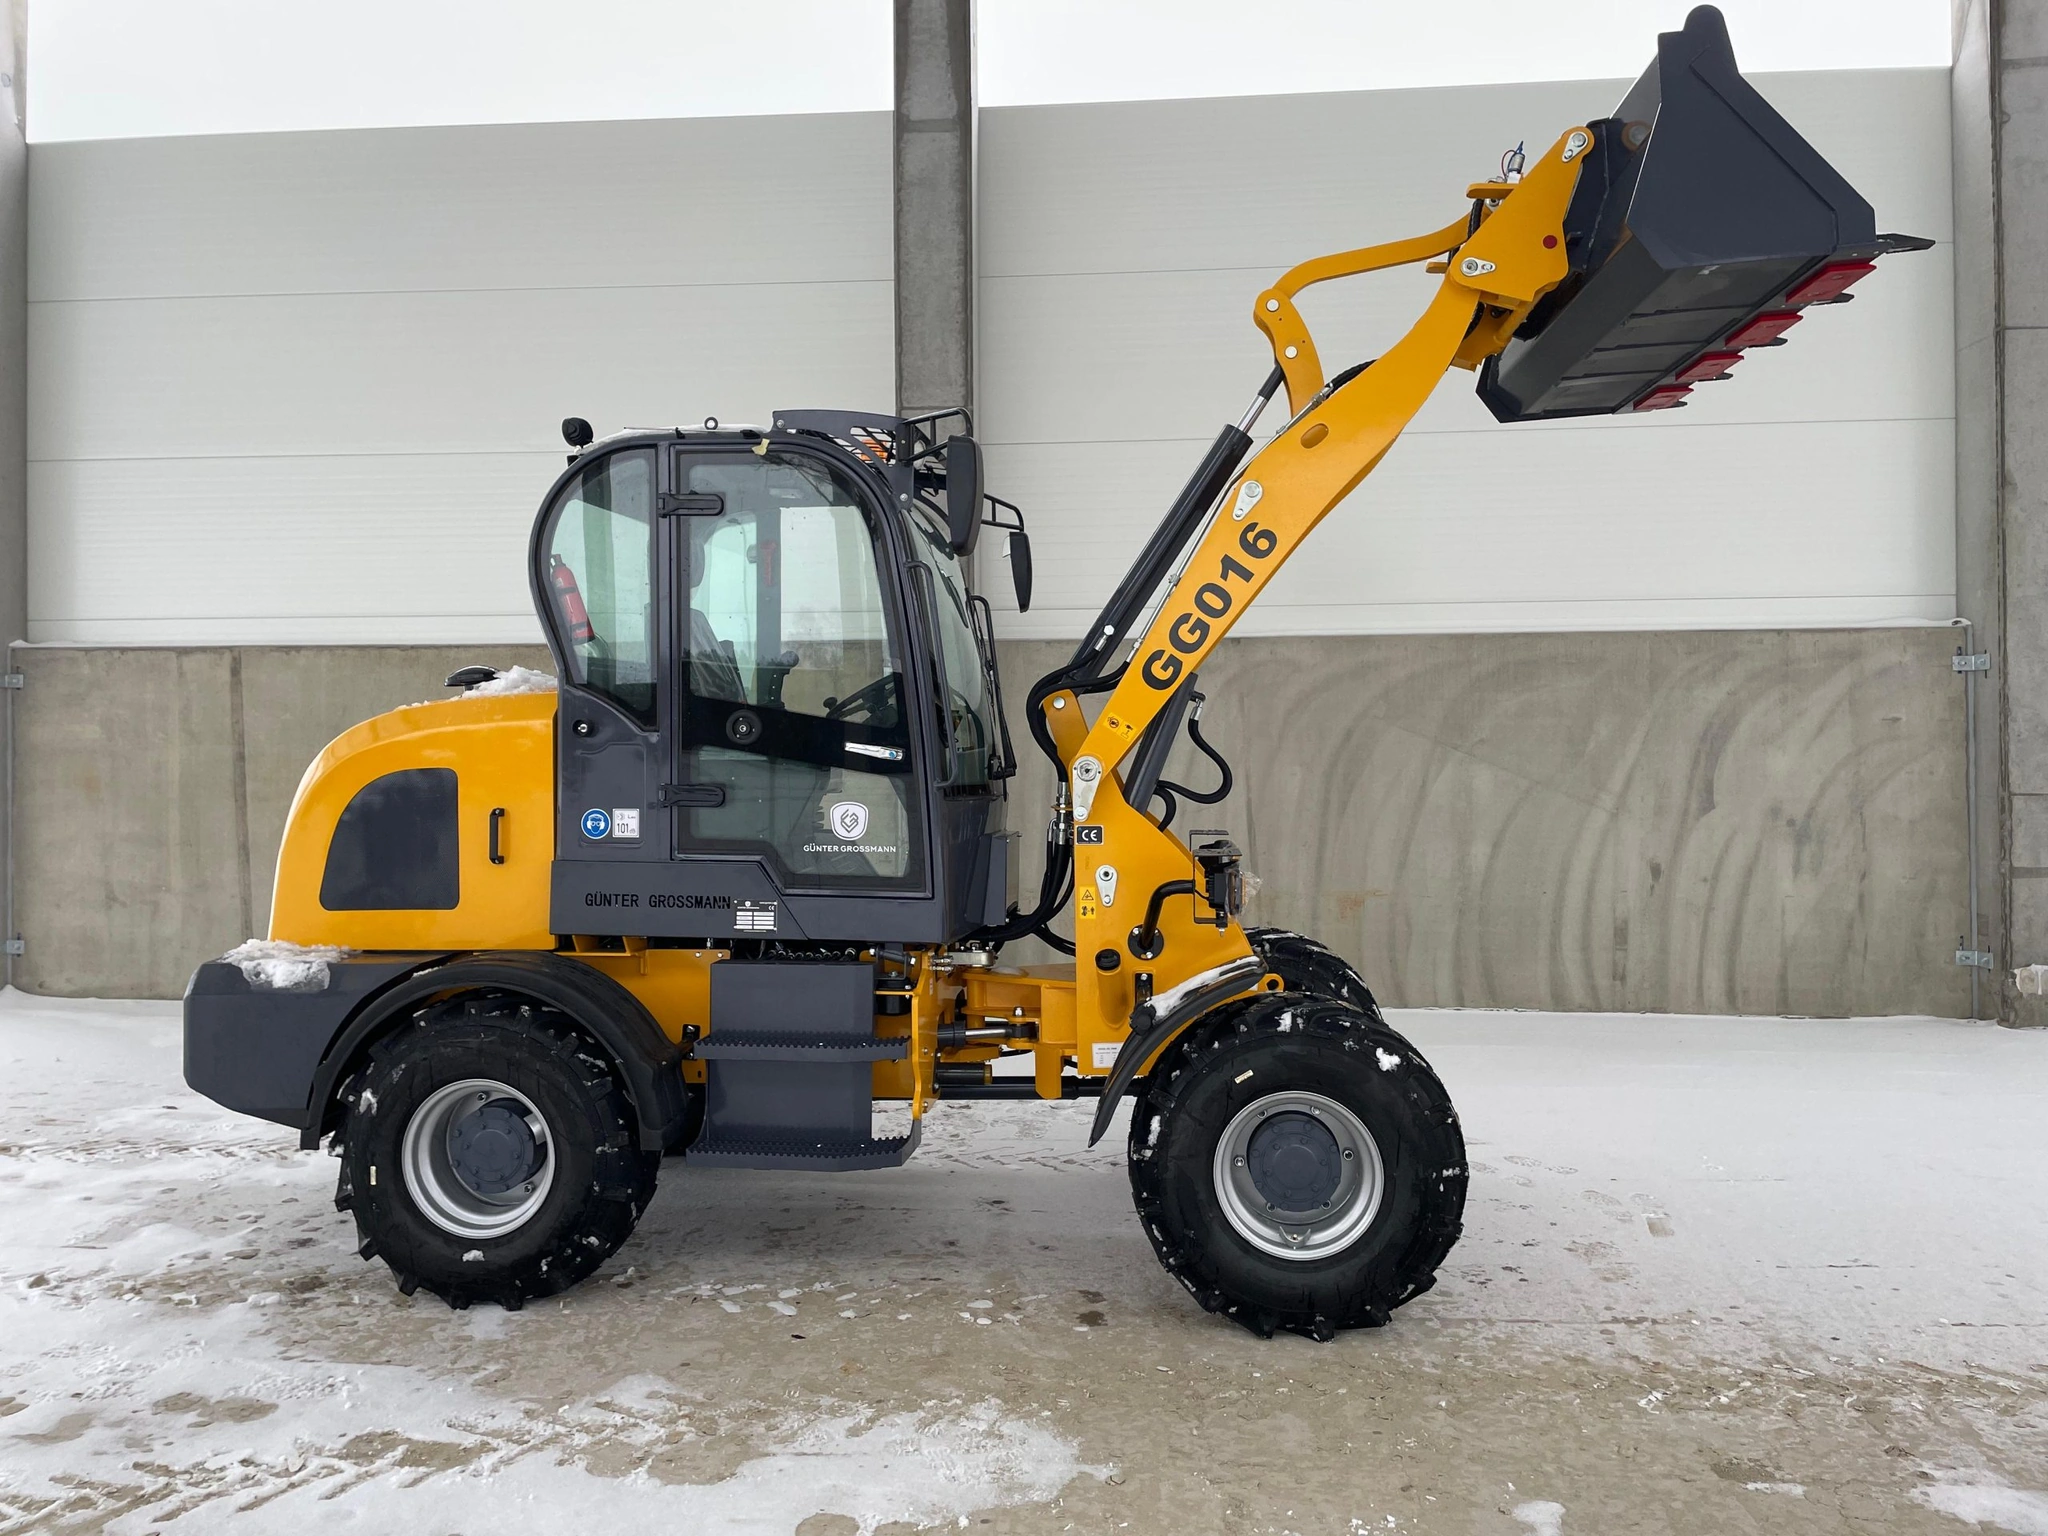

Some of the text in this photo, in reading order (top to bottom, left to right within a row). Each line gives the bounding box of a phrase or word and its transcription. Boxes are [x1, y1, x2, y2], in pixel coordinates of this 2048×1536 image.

[1141, 522, 1277, 690] GG016
[617, 823, 629, 834] 101
[1082, 829, 1098, 841] CE
[803, 843, 896, 853] GÜNTER GROSSMANN
[585, 891, 731, 909] GÜNTER GROSSMANN
